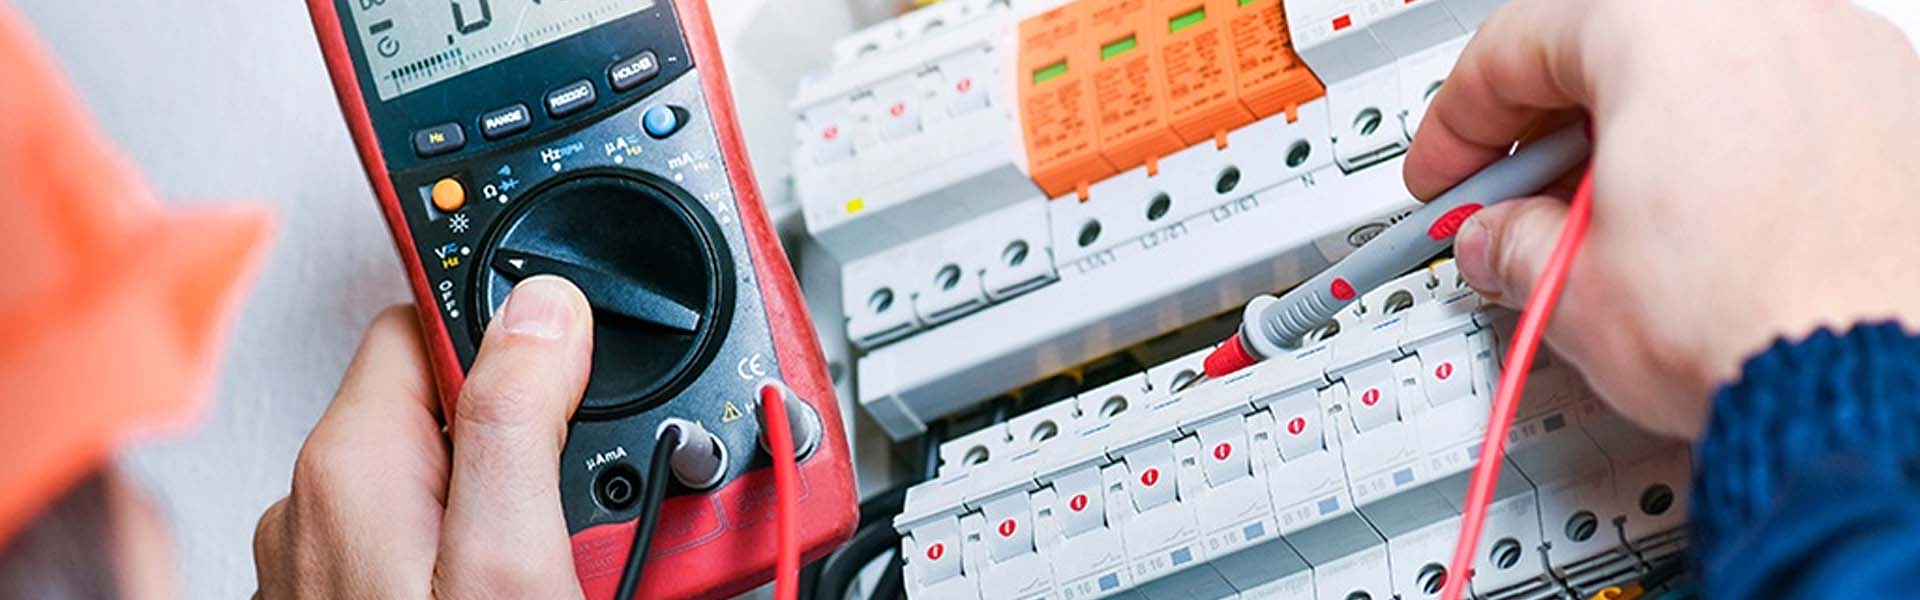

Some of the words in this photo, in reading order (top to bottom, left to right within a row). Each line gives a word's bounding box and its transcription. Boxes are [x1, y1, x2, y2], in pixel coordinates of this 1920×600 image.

[485, 110, 522, 130] RANGE
[428, 132, 446, 144] Hz
[439, 280, 456, 311] OFF
